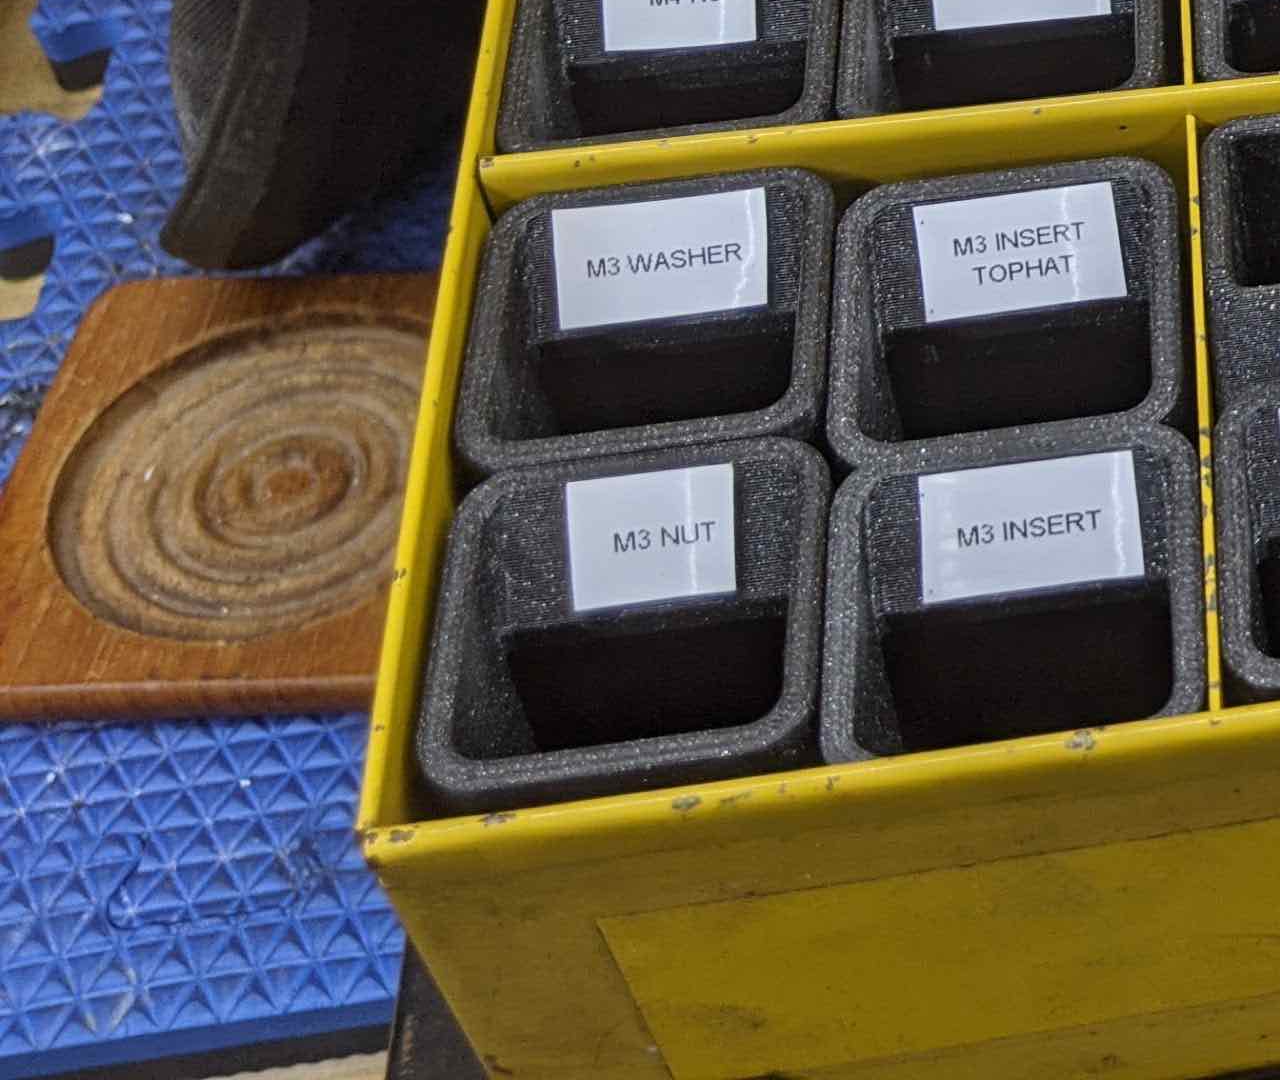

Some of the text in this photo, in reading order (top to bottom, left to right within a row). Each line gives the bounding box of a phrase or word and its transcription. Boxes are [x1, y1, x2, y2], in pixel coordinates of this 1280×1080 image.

[952, 221, 1085, 257] M3 INSERT
[586, 242, 743, 279] M3 WASHER
[971, 254, 1073, 286] TOPHAT
[613, 520, 716, 553] M3 NUT
[957, 509, 1102, 548] M3 INSERT
